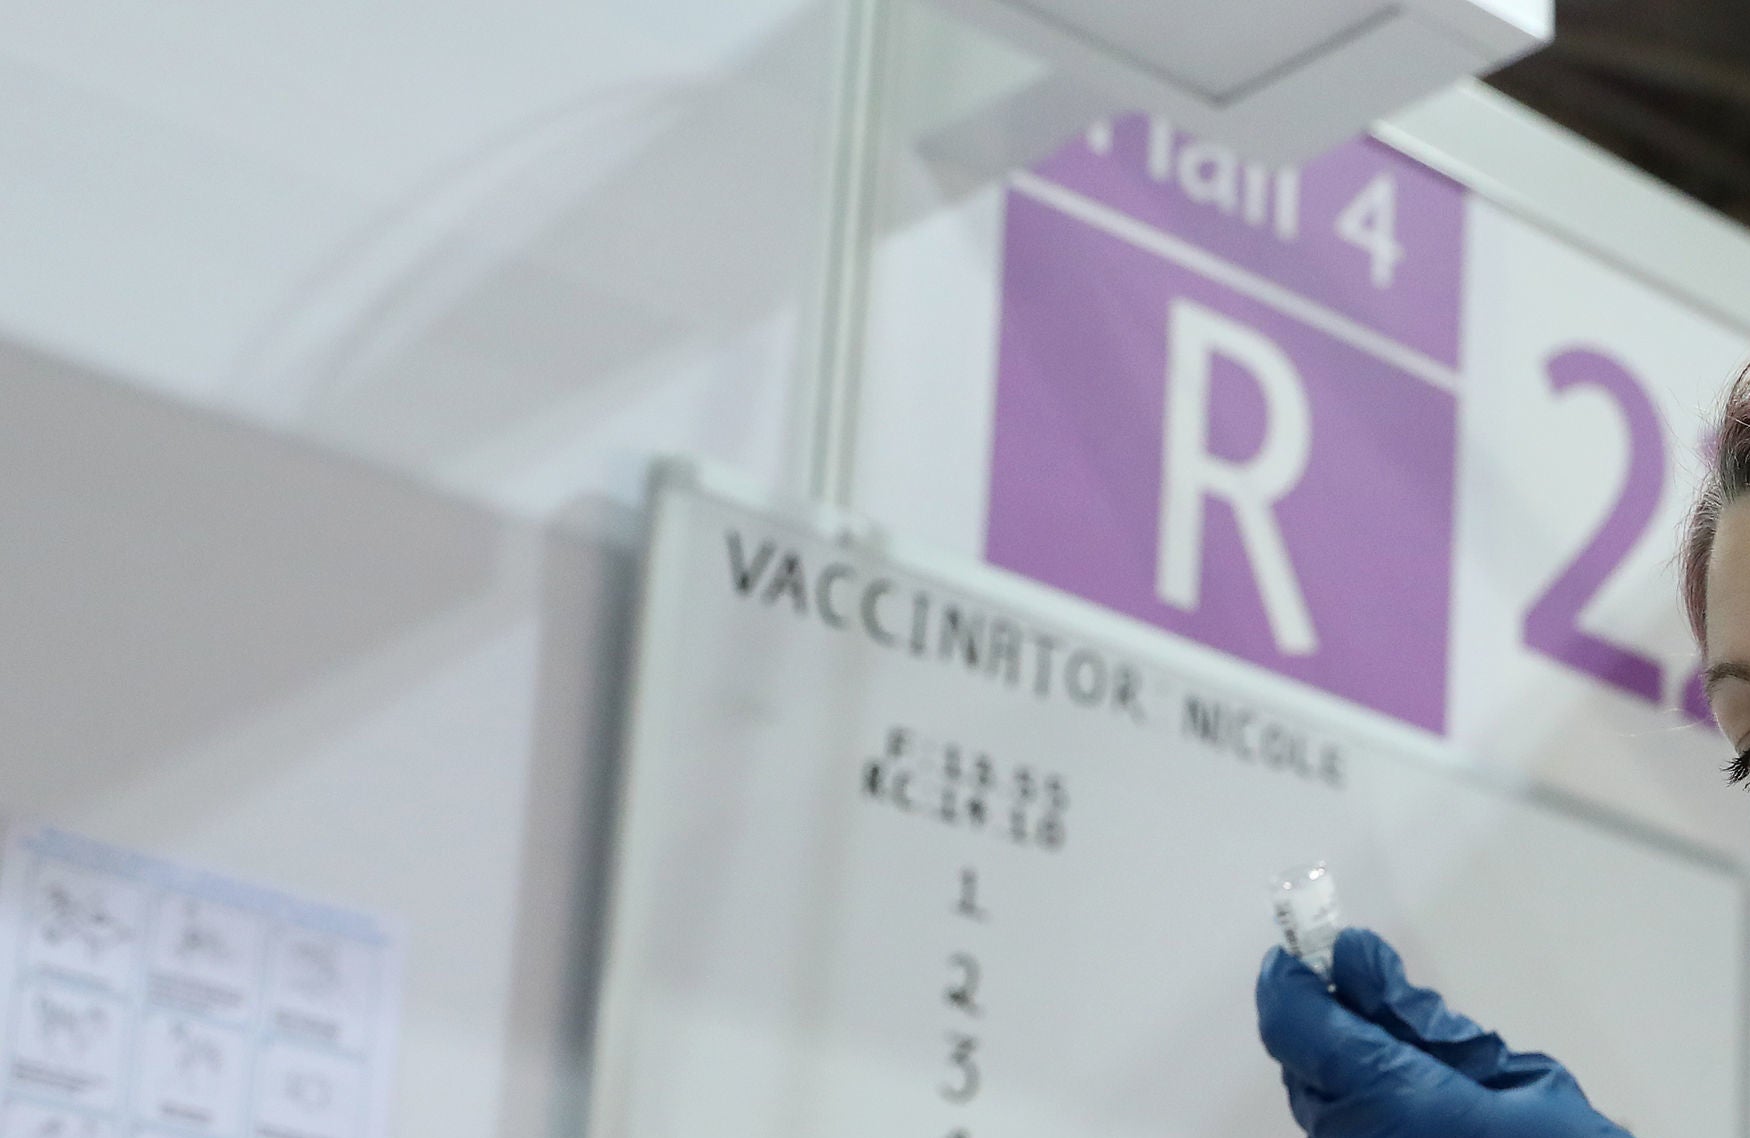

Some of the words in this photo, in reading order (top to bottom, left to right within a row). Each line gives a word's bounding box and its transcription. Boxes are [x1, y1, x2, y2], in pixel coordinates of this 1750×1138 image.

[1334, 166, 1404, 290] 4
[1156, 298, 1318, 656] R
[1182, 693, 1347, 788] NICOLE
[950, 865, 990, 922] 1
[941, 950, 985, 1019] 2
[937, 1030, 982, 1104] 3
